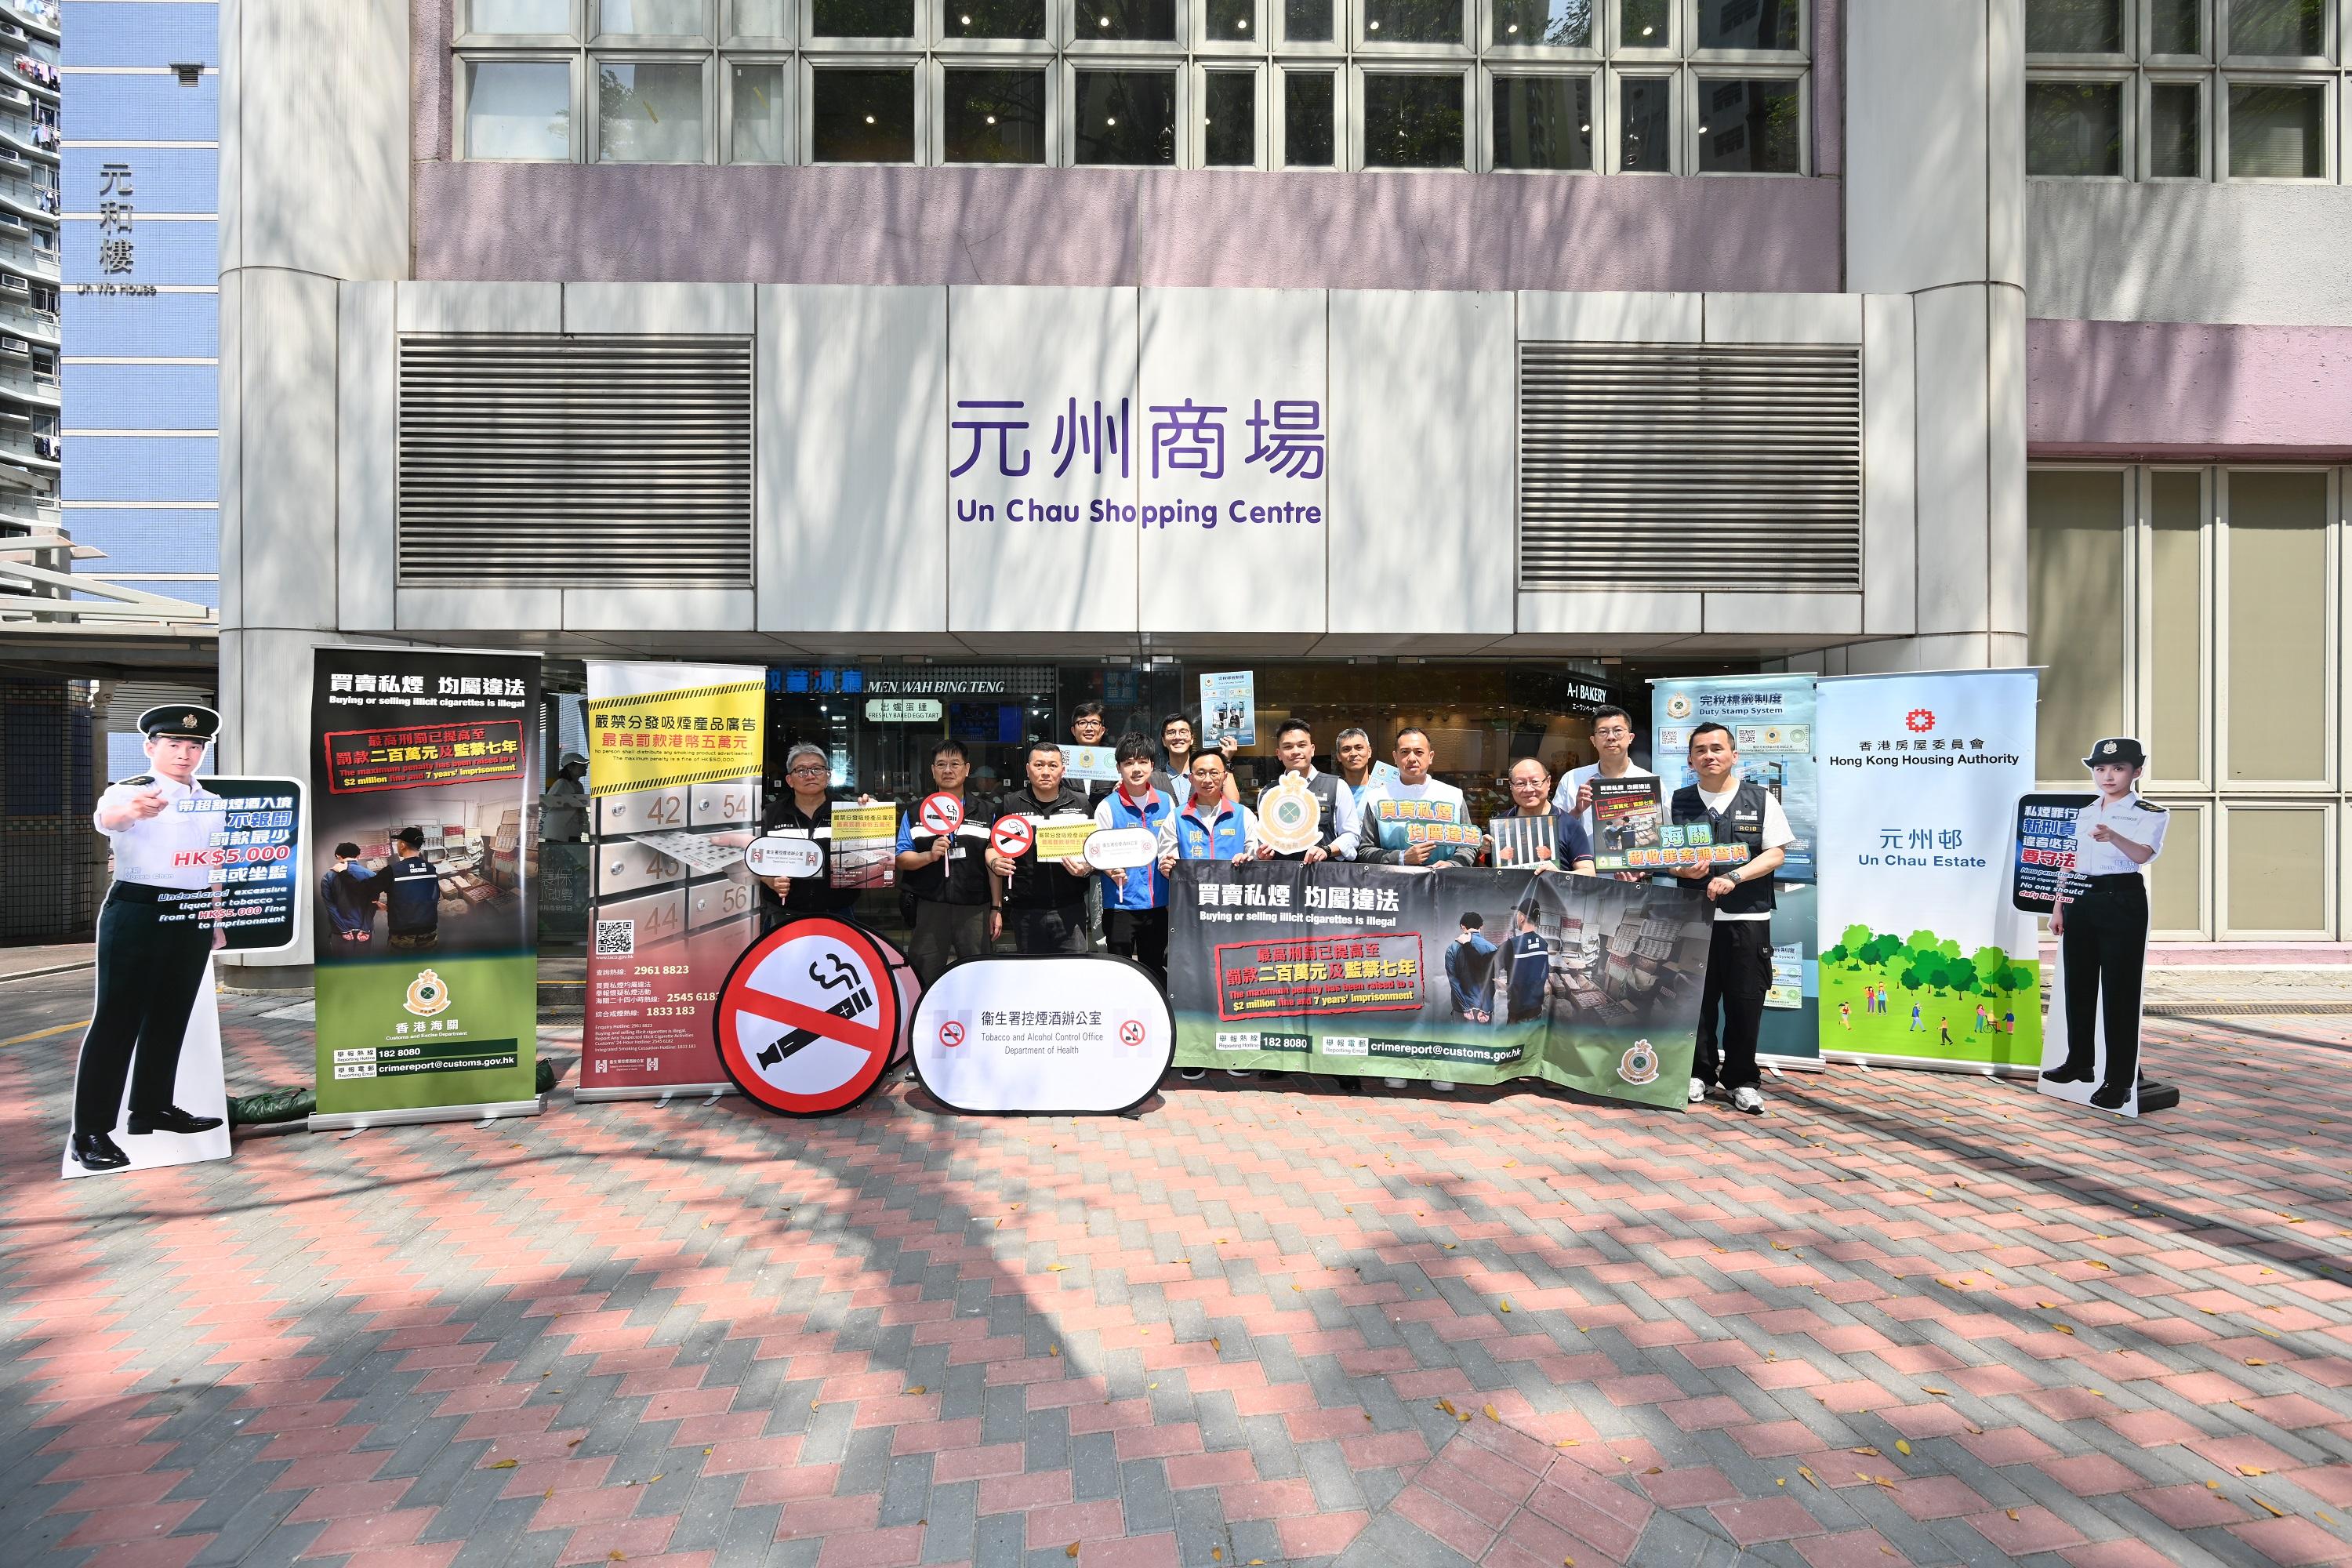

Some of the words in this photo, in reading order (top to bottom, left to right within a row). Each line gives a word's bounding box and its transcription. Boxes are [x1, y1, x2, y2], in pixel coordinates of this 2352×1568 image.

[100, 163, 133, 274] 元和樓
[76, 282, 93, 296] Un
[96, 282, 116, 296] Wo
[120, 283, 157, 296] House
[950, 397, 1325, 479] 元州商場
[957, 499, 994, 522] Un
[1007, 498, 1079, 522] Chau
[1090, 498, 1218, 528] Shopping
[1229, 499, 1322, 523] Centre
[330, 673, 424, 693] 買賣私煙
[438, 677, 525, 696] 均屬違法
[868, 681, 898, 693] MEN
[902, 681, 935, 693] WAH
[935, 681, 967, 693] BING
[969, 681, 1004, 693] TENG
[1567, 683, 1578, 698] A-1
[1581, 684, 1606, 702] BAKERY
[329, 695, 363, 706] Buying
[379, 697, 410, 706] selling
[413, 697, 437, 706] illicit
[440, 699, 485, 707] cigarettes
[498, 699, 524, 708] illegal
[595, 714, 756, 731] 嚴禁分發吸煙產品廣告
[368, 729, 485, 747] 最高刑罰已提高至
[602, 733, 747, 749] 最高罰款港幣五萬元
[1859, 739, 1984, 751] 香港房屋委員會
[336, 740, 517, 766] 罰款二百萬元及監禁七年
[1830, 756, 1862, 767] Hong
[1866, 756, 1898, 767] Kong
[1902, 755, 1954, 766] Housing
[1957, 753, 2019, 765] Authority
[343, 778, 356, 786] $2
[358, 776, 387, 786] million
[408, 772, 425, 781] and
[460, 764, 516, 776] imprisonment
[177, 797, 292, 812] 帶超額煙酒入境
[647, 796, 681, 825] 42
[724, 794, 747, 818] 54
[1379, 801, 1454, 822] 買賣私煙
[2024, 805, 2079, 820] 私煙罪行
[227, 811, 292, 829] 不報關
[2023, 818, 2077, 836] 新刑責
[209, 830, 290, 848] 罰款最少
[1406, 824, 1482, 845] 均屬違法
[1660, 825, 1711, 847] 海關
[1880, 829, 1962, 849] 元州邨
[2022, 836, 2078, 851] 違者必究
[172, 845, 290, 867] HK$5,000
[1858, 855, 1878, 866] Un
[1885, 855, 1927, 866] Chau
[1934, 856, 1986, 867] Estate
[2021, 848, 2077, 868] 要守法
[208, 865, 288, 884] 甚或坐監
[2037, 877, 2063, 885] cigarette
[2038, 869, 2073, 879] penalties
[158, 889, 230, 902] Undeclared
[234, 887, 288, 895] excessive
[1198, 884, 1290, 907] 買賣私煙
[1305, 885, 1399, 912] 均屬違法
[2019, 890, 2038, 900] defy
[2056, 895, 2074, 903] law
[2053, 885, 2085, 895] should
[230, 897, 273, 906] tobacco
[722, 885, 747, 913] 56
[213, 916, 285, 928] imprisonment
[644, 902, 677, 935] 44
[1200, 912, 1232, 923] Buying
[1235, 913, 1243, 921] or
[1247, 912, 1277, 924] selling
[1279, 912, 1303, 923] illicit
[1305, 914, 1352, 926] cigarettes
[1356, 916, 1364, 925] is
[1367, 916, 1396, 927] illegal
[1257, 942, 1380, 963] 最高刑罰已提高至
[634, 966, 660, 975] 2961
[662, 965, 689, 974] 8823
[1225, 958, 1416, 986] 罰款二百萬元及監禁七年
[666, 993, 693, 1002] 2545
[1233, 1001, 1244, 1011] $2
[1246, 999, 1276, 1009] million
[1279, 998, 1294, 1007] fine
[1297, 997, 1312, 1006] and
[1314, 996, 1319, 1005] 7
[1351, 991, 1413, 1004] imprisonment
[647, 1007, 672, 1016] 1833
[675, 1007, 695, 1015] 183
[396, 1019, 459, 1034] 香港海關
[981, 1033, 1010, 1041] Tobacco
[1013, 1033, 1025, 1041] and
[1028, 1033, 1053, 1041] Alcohol
[1055, 1033, 1080, 1041] Control
[1082, 1033, 1104, 1041] Office
[1219, 1034, 1258, 1043] 舉報熱線
[1263, 1036, 1281, 1047] 182
[1283, 1038, 1307, 1048] 8080
[1326, 1039, 1367, 1047] 舉報電郵
[397, 1048, 420, 1057] 8080
[1004, 1046, 1045, 1055] Department
[1047, 1046, 1054, 1054] of
[1057, 1046, 1079, 1054] Health
[1370, 1042, 1522, 1061] crimereport@customs.gov.hk
[379, 1056, 514, 1073] crimereport@customs.gov.hk
